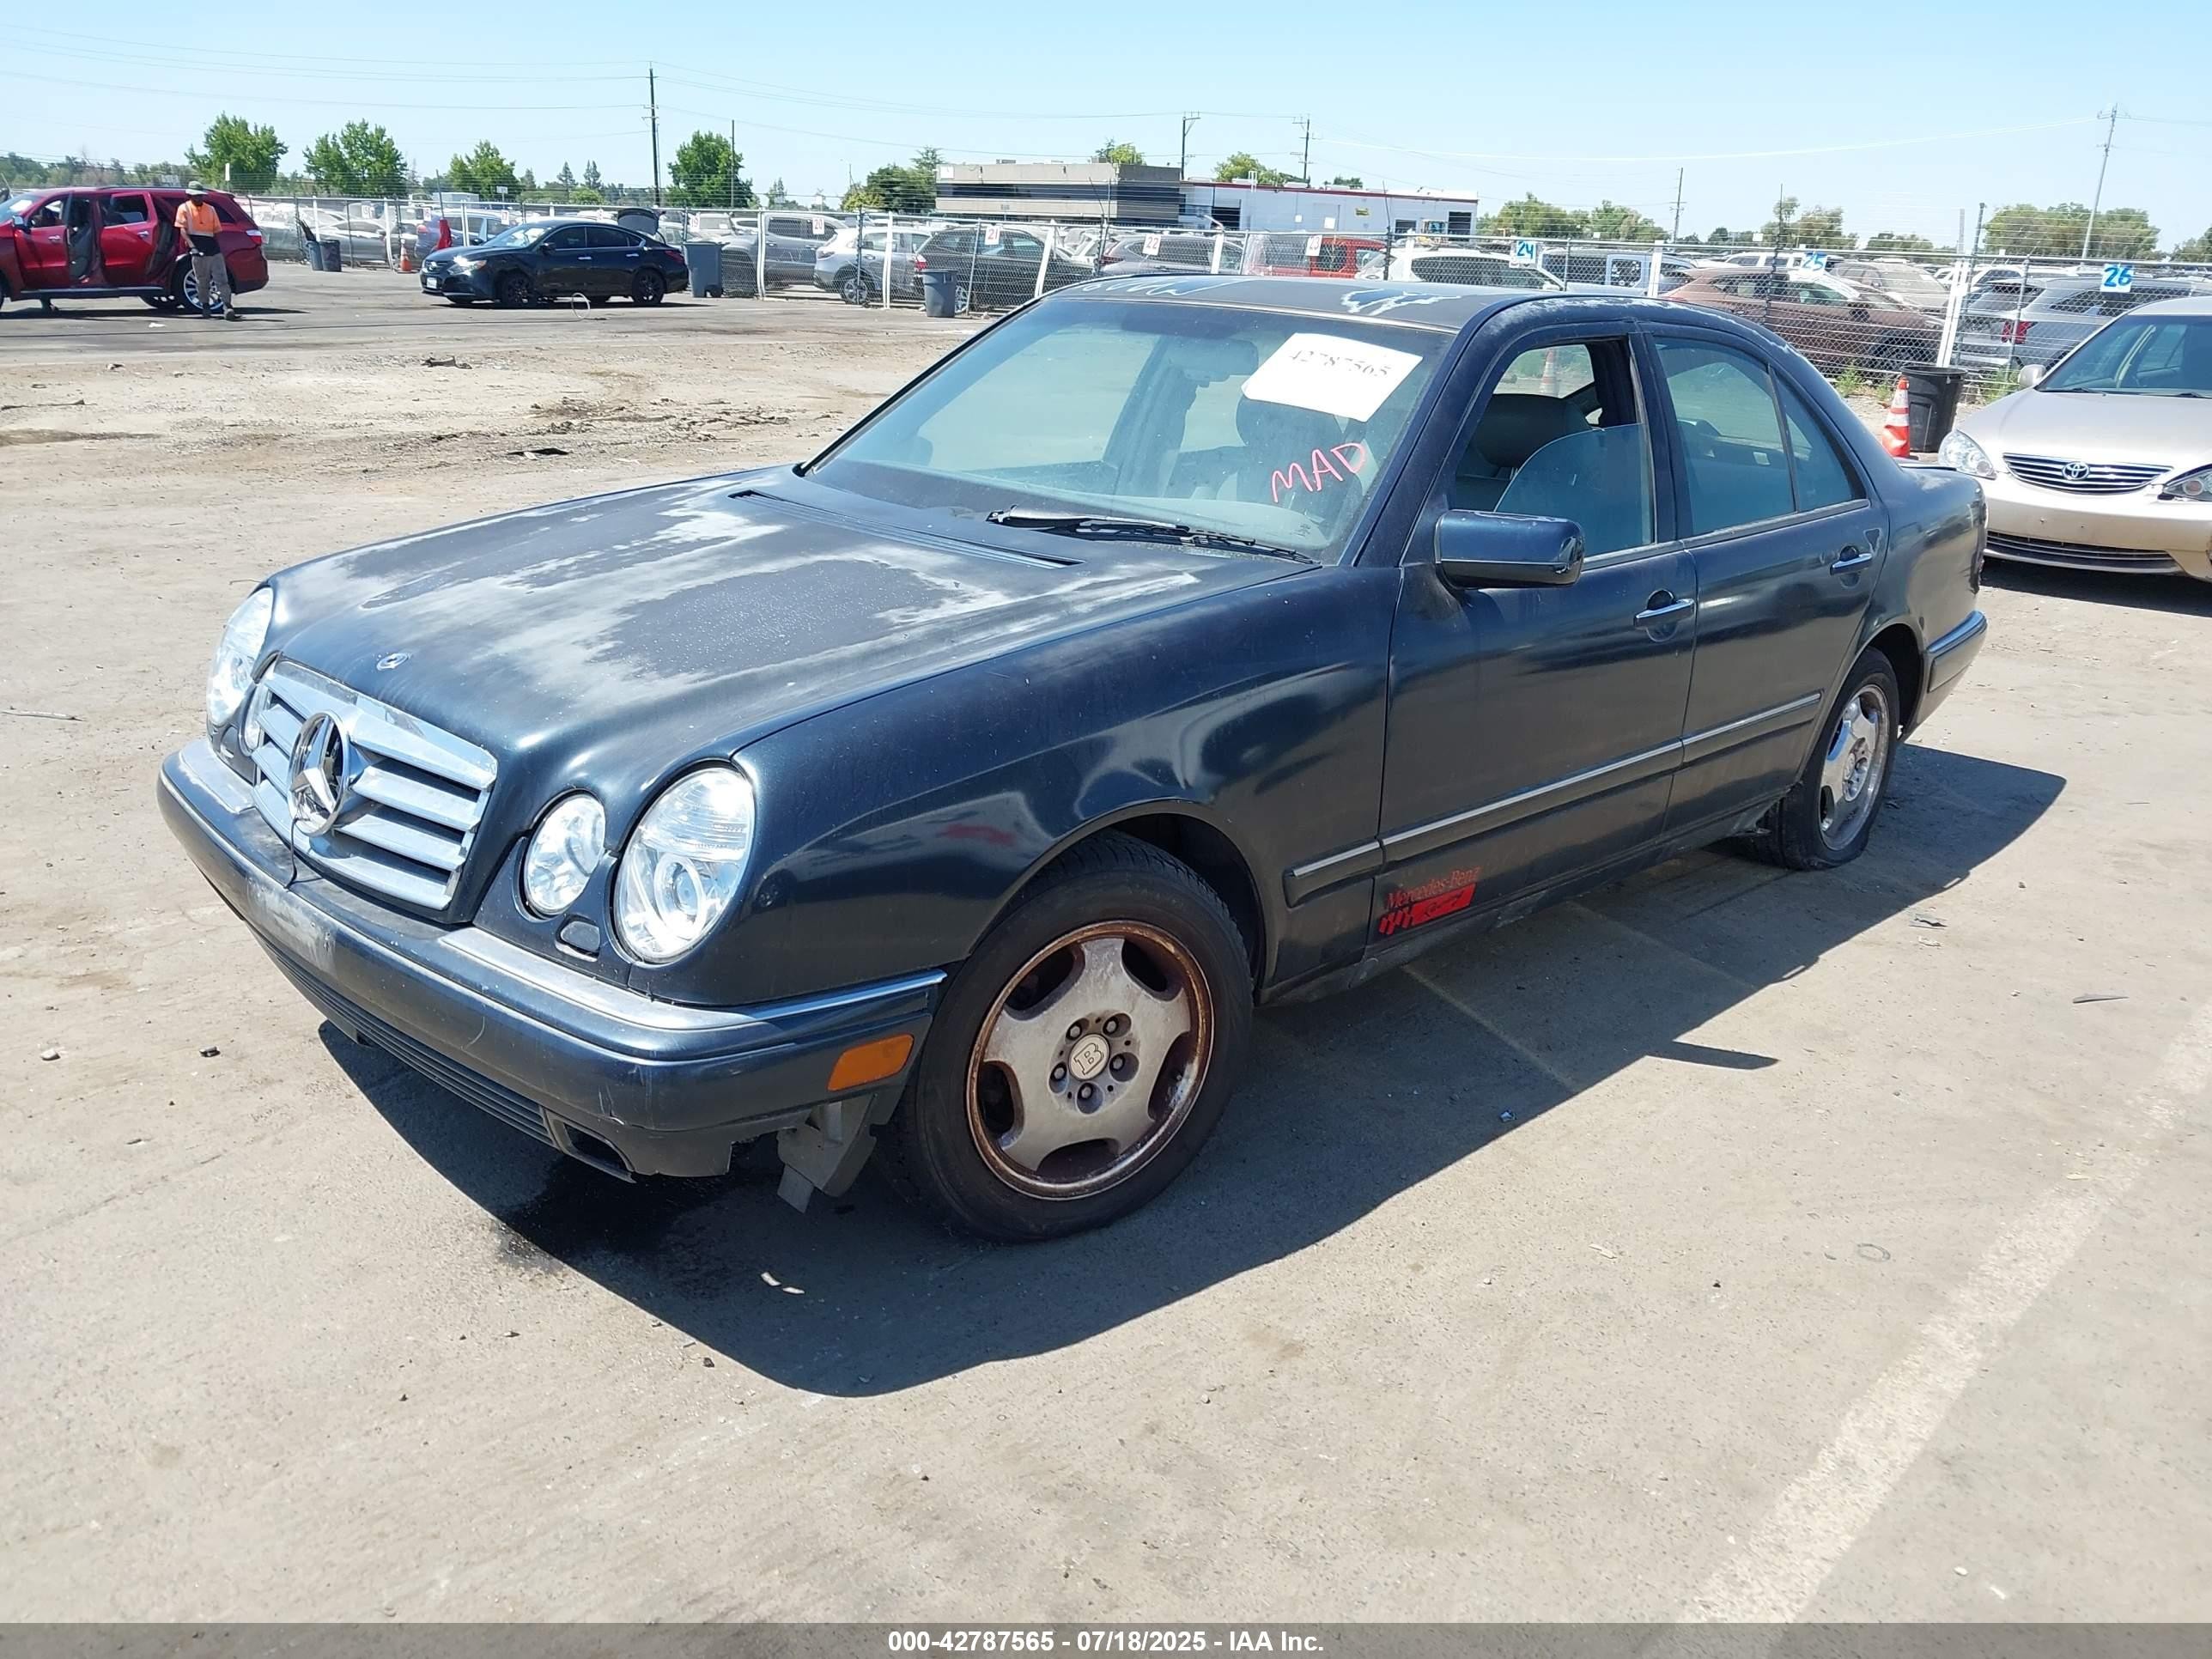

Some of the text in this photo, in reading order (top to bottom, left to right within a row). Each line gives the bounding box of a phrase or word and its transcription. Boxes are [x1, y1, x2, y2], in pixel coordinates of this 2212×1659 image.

[814, 219, 822, 229] 20
[988, 229, 998, 240] 21
[1146, 237, 1158, 248] 22
[1517, 240, 1534, 259] 24
[1802, 252, 1827, 271] 25
[2104, 264, 2133, 287] 26
[1272, 441, 1366, 504] MAD
[1386, 866, 1480, 910] Mercedes-Benz
[1073, 1042, 1105, 1075] B
